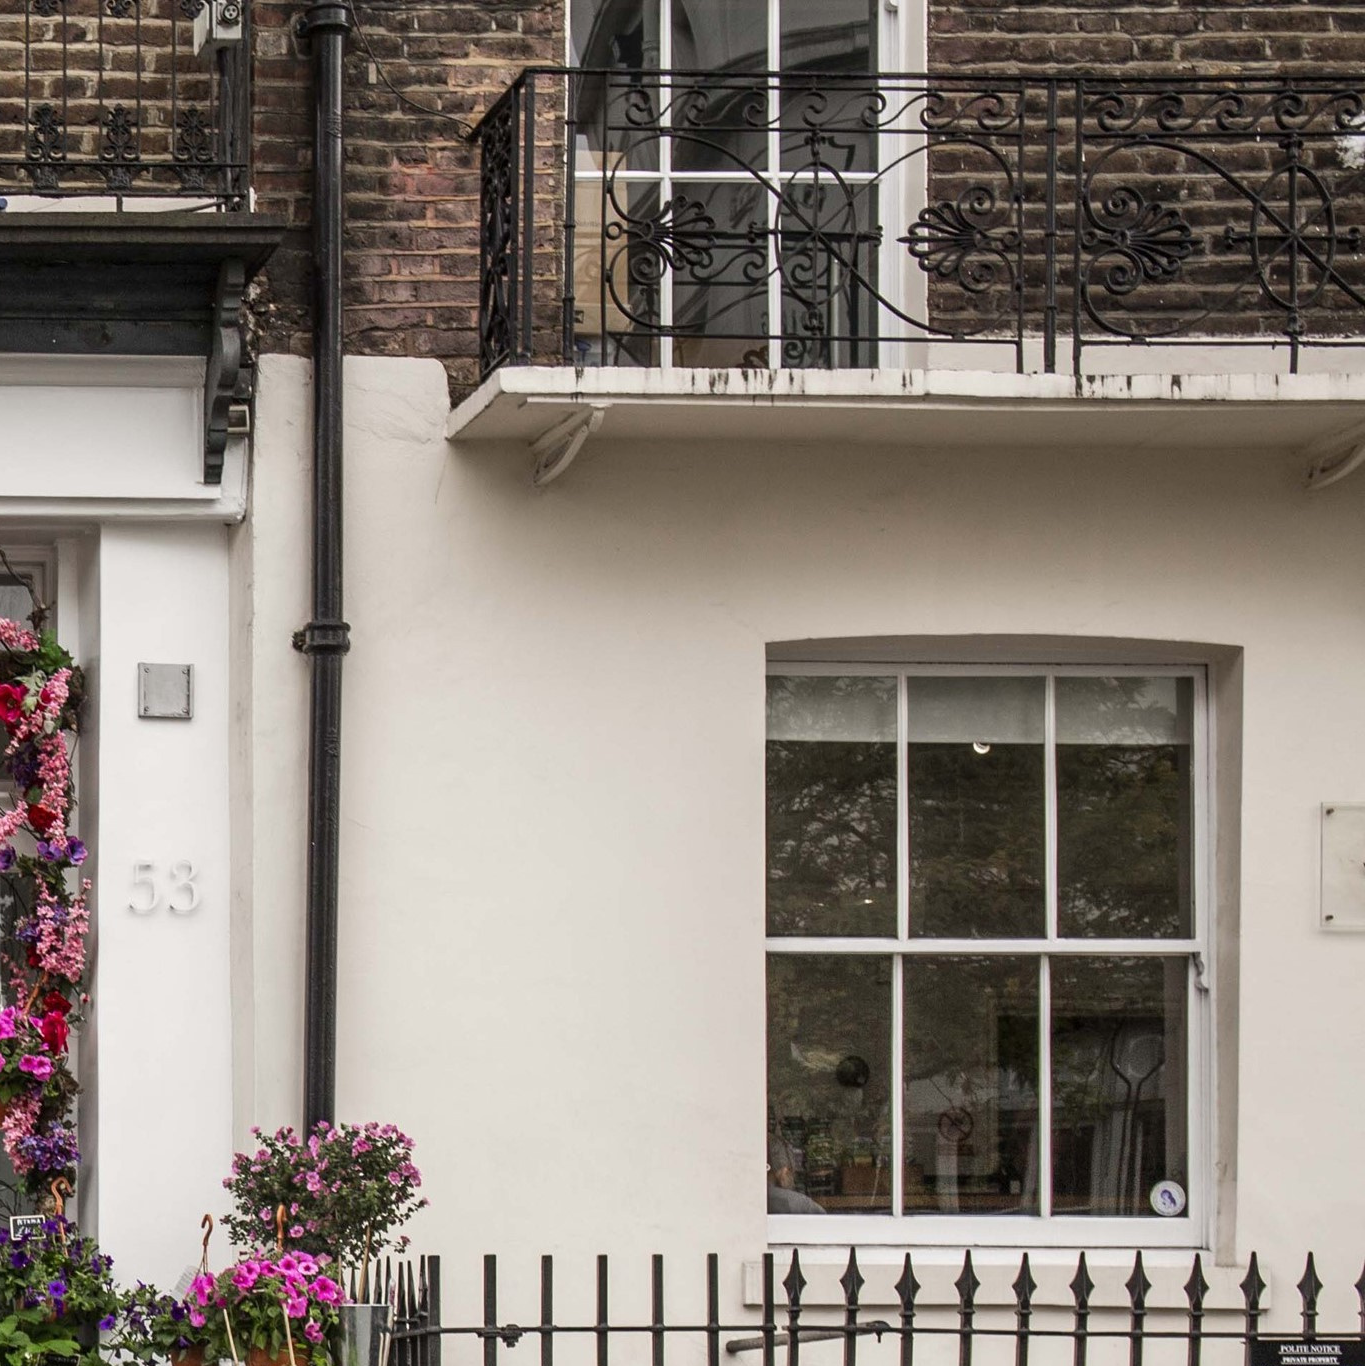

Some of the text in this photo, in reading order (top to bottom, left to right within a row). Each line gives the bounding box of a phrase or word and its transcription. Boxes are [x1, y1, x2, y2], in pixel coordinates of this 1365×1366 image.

[128, 859, 199, 915] 53
[1280, 1344, 1341, 1353] POLITE NOTICE
